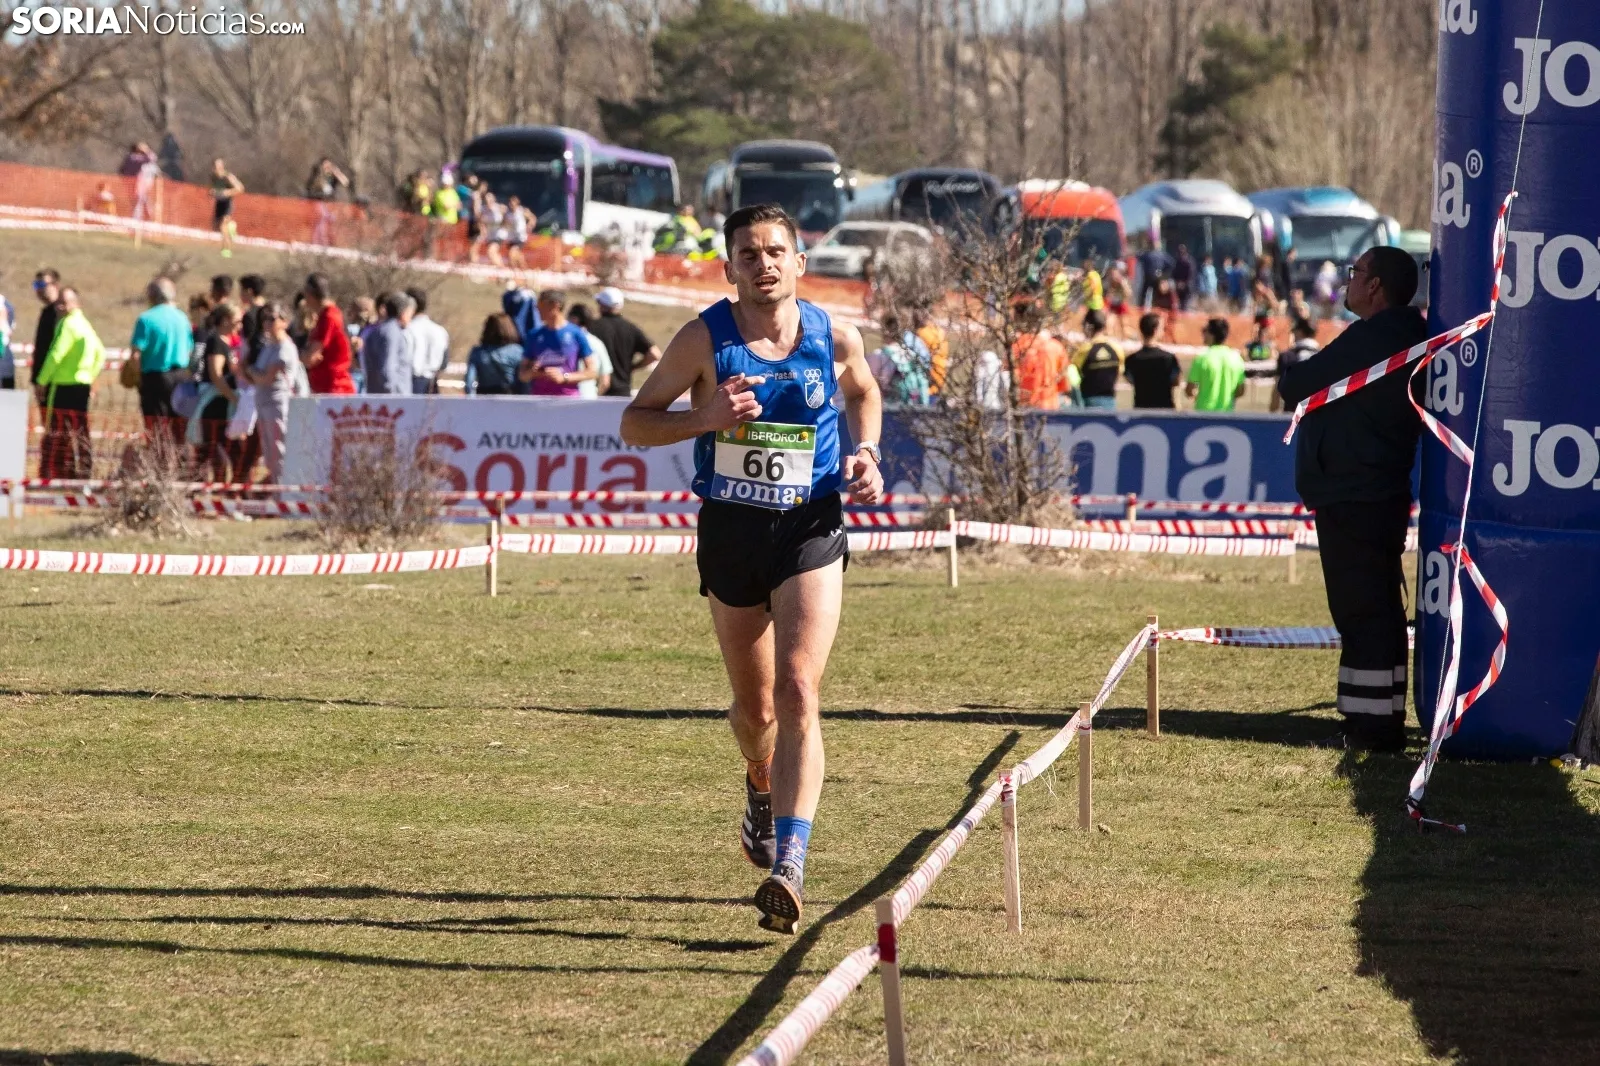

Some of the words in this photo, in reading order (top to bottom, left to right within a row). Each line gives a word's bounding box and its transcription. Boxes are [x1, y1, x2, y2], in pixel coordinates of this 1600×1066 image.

[477, 431, 651, 452] AYUNTAMIEN
[412, 432, 648, 516] Soria
[743, 449, 784, 482] 66
